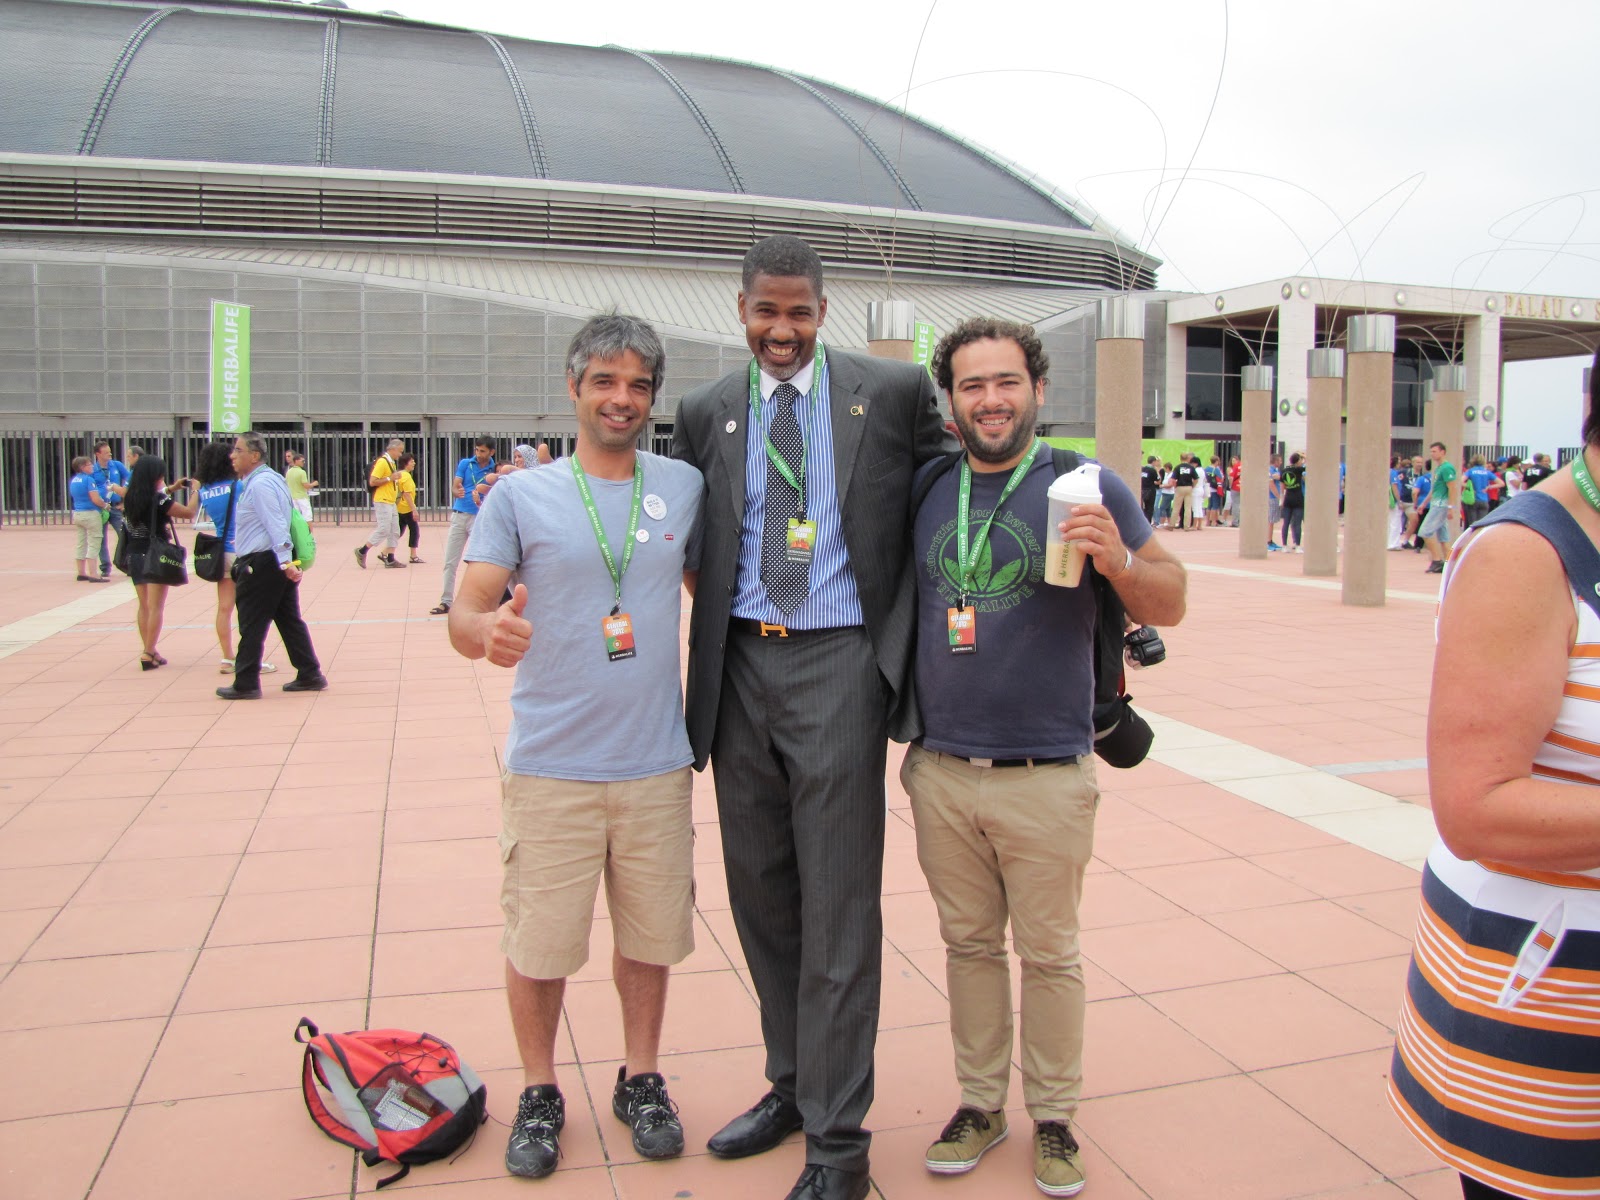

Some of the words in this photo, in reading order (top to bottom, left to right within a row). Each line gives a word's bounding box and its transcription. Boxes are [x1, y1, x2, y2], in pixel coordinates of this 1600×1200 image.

[1504, 294, 1563, 318] PALAU
[224, 307, 239, 408] HERBALIFE
[1010, 463, 1027, 487] HERBALIFE
[591, 511, 604, 537] HERBALIFE
[630, 504, 639, 530] HERBALIFE
[926, 518, 958, 579] Nutritio
[1002, 510, 1042, 553] better
[971, 532, 985, 561] HERBALIFE
[603, 548, 617, 576] HERBALIFE
[937, 582, 1035, 613] HEBALIFE
